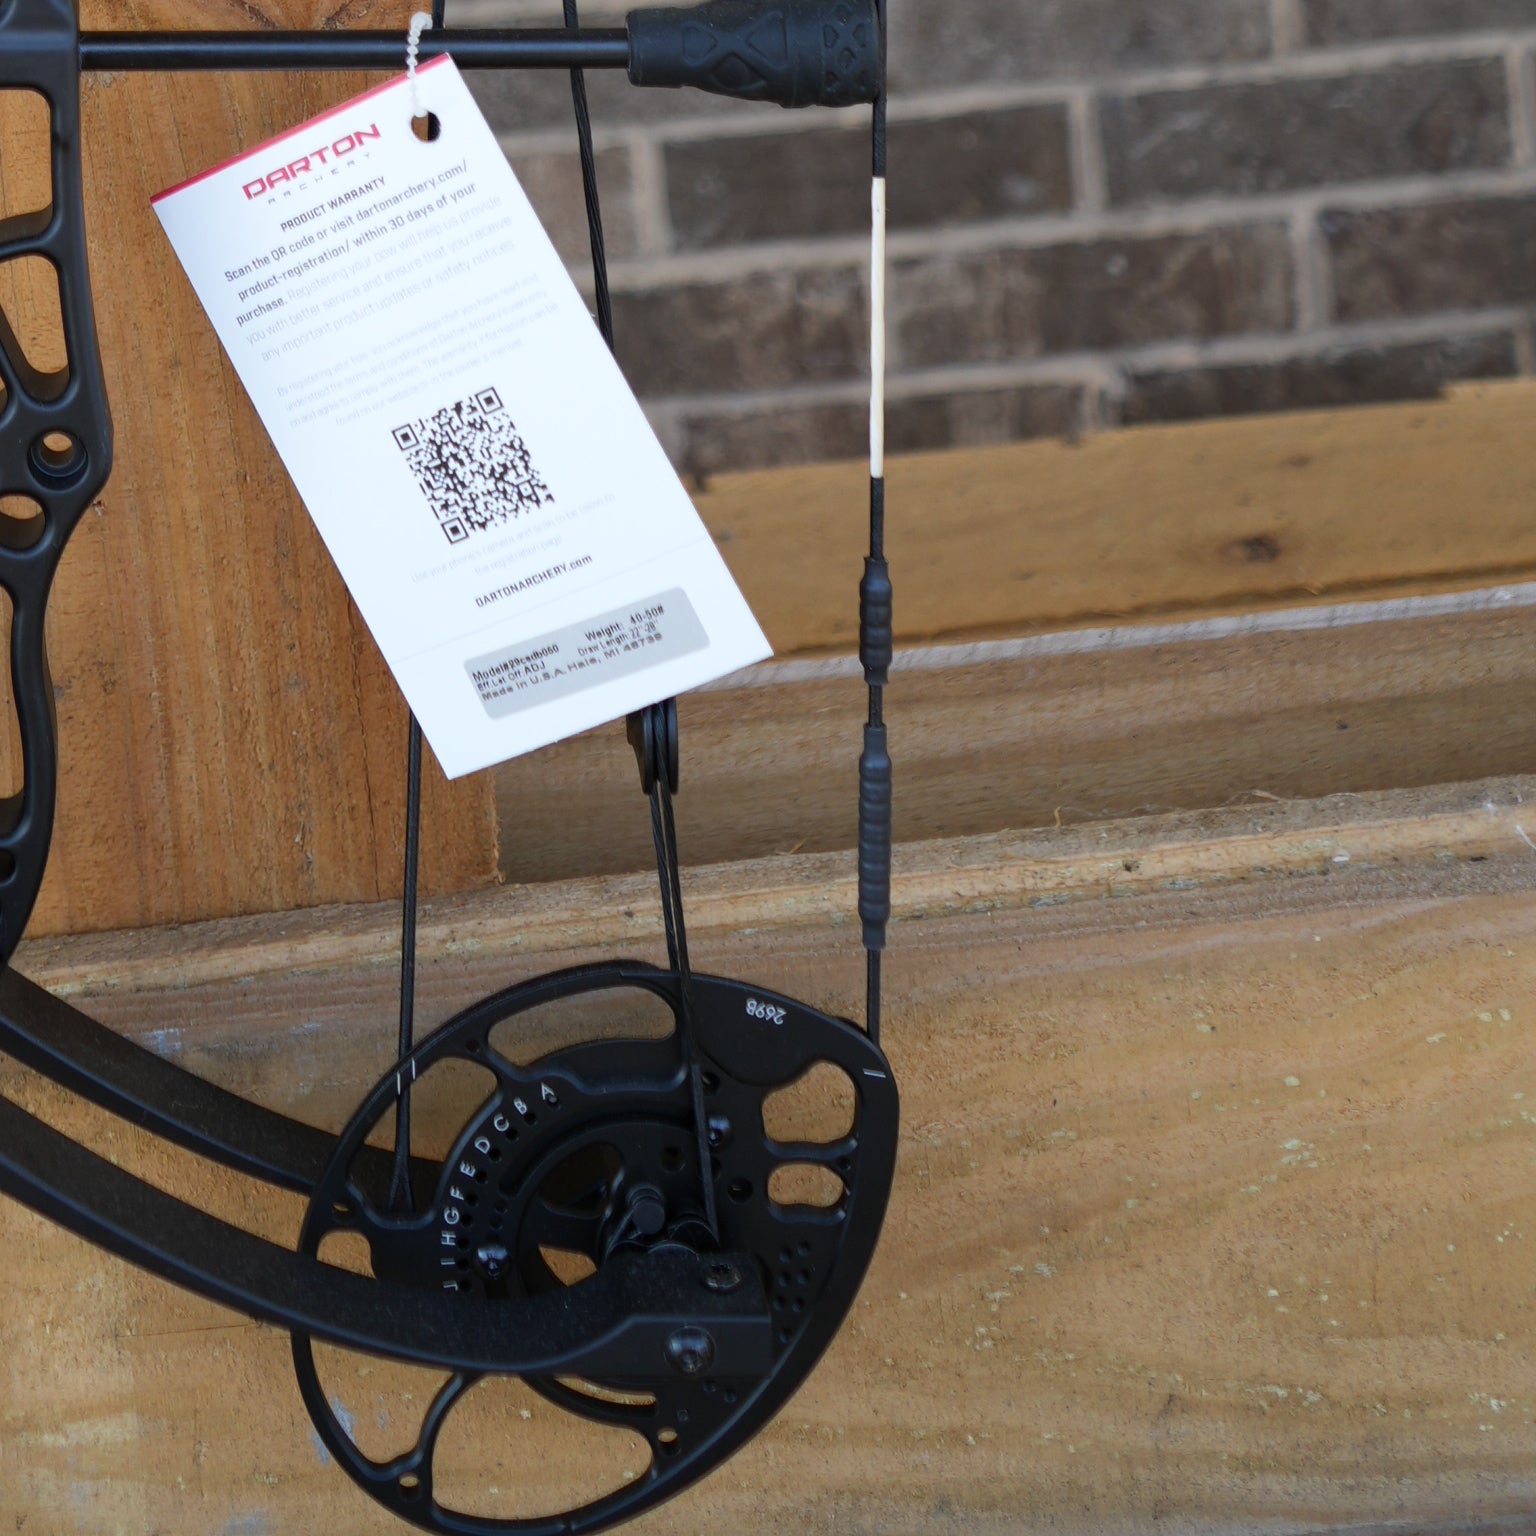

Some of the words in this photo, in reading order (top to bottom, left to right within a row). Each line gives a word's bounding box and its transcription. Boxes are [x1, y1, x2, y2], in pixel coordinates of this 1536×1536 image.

[242, 122, 381, 200] DARTON
[267, 151, 372, 206] ARCHERY
[279, 204, 327, 232] PRODUCT
[327, 175, 387, 210] WARRANTY
[223, 261, 252, 282] Scan
[250, 253, 271, 270] the
[269, 245, 289, 262] QR
[286, 232, 315, 253] code
[315, 228, 329, 240] or
[328, 214, 354, 233] visit
[353, 158, 471, 224] dartonarchery.com/
[236, 238, 354, 303] product-registration/
[350, 222, 388, 247] within
[387, 215, 405, 230] 30
[404, 200, 436, 224] days
[433, 194, 449, 209] of
[449, 182, 479, 205] your
[234, 292, 289, 327] purchase.
[285, 264, 349, 304] Registering
[347, 256, 373, 275] your
[396, 232, 419, 251] will
[456, 192, 504, 224] provide
[245, 328, 267, 347] you
[264, 317, 289, 336] with
[287, 302, 321, 325] better
[320, 284, 361, 311] service
[359, 273, 384, 292] and
[382, 256, 424, 282] ensure
[421, 244, 448, 264] that
[468, 215, 513, 243] receive
[260, 345, 281, 363] any
[279, 321, 332, 354] important
[330, 301, 376, 331] product
[373, 280, 422, 311] updates
[474, 552, 594, 609] DARTONARCHERY.com
[576, 641, 600, 657] Draw
[745, 998, 787, 1025] 269B
[541, 1082, 555, 1101] A
[514, 1097, 528, 1115] B
[493, 1113, 509, 1132] C
[474, 1136, 491, 1155] D
[459, 1160, 476, 1178] E
[450, 1185, 465, 1201] F
[443, 1206, 460, 1225] G
[440, 1230, 456, 1246] H
